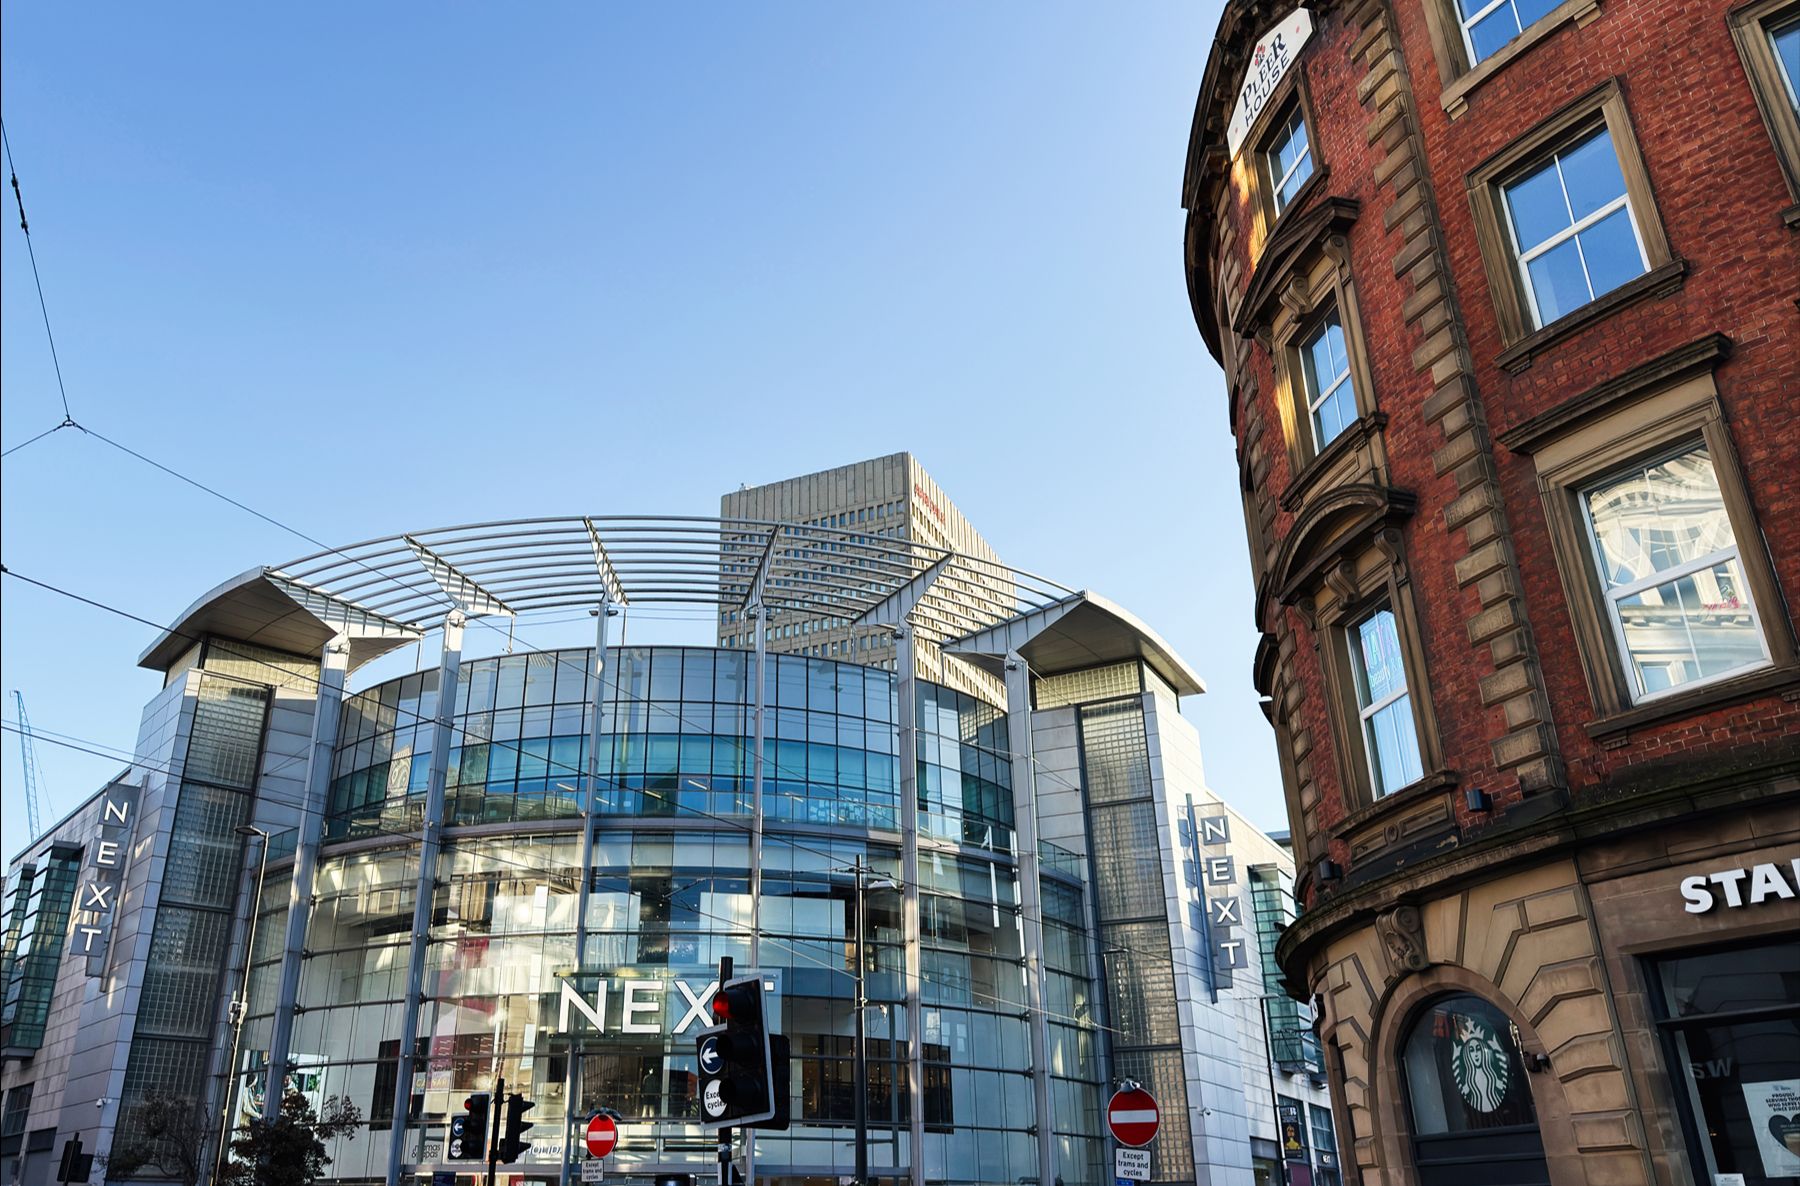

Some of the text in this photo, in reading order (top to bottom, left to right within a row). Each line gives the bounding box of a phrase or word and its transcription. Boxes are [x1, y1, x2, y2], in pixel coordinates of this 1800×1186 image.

[1242, 33, 1286, 112] PLEER
[1245, 50, 1290, 128] HOUSE
[81, 799, 129, 952] NEXT
[1204, 818, 1241, 965] NEXT
[558, 979, 775, 1034] NEX
[1122, 1151, 1144, 1160] Except
[1123, 1169, 1143, 1177] cycles
